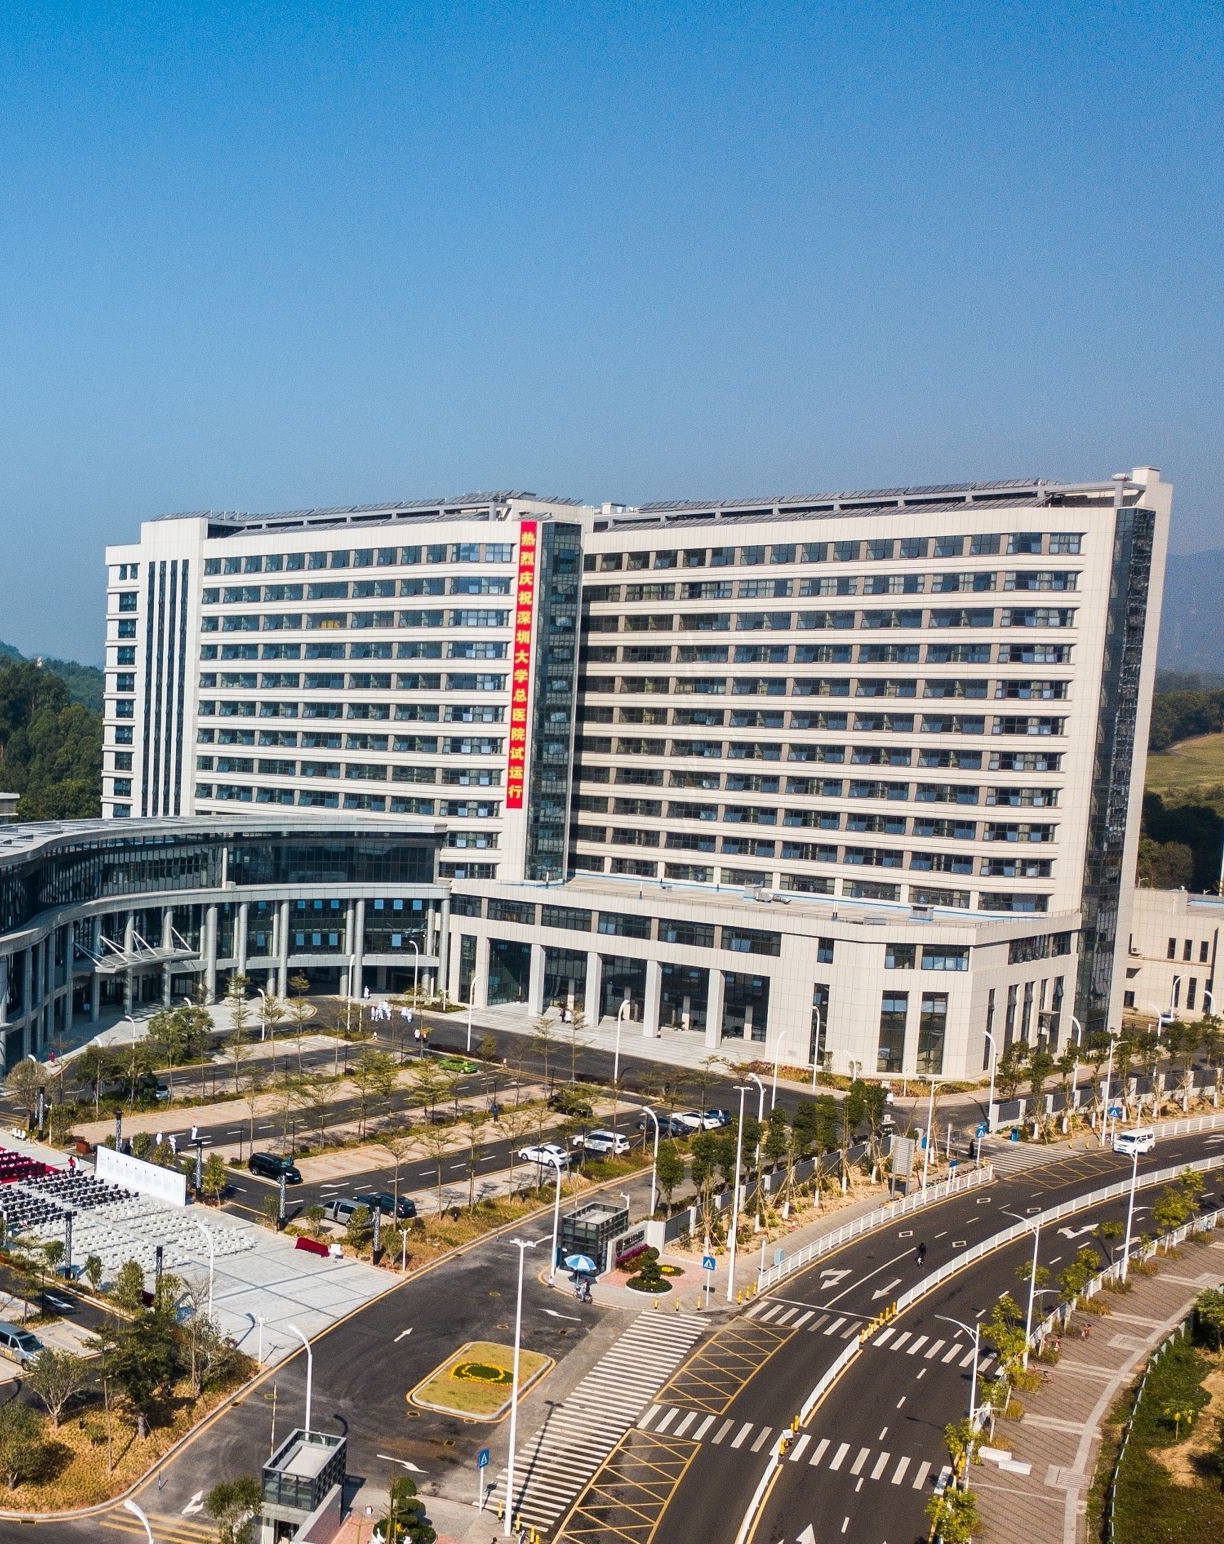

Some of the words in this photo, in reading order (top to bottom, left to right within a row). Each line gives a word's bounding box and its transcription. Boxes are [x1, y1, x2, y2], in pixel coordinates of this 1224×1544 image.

[508, 531, 536, 799] 热烈庆祝深圳大学总医院试运行
